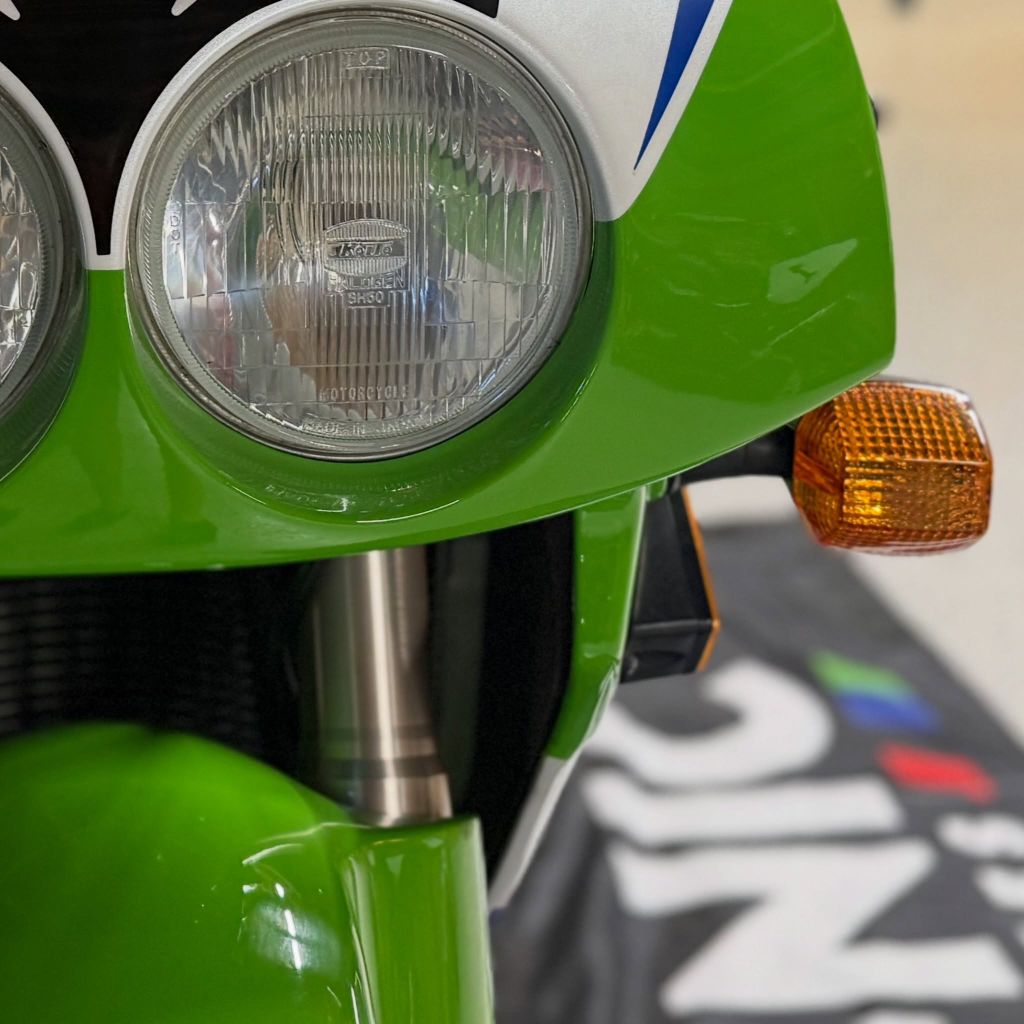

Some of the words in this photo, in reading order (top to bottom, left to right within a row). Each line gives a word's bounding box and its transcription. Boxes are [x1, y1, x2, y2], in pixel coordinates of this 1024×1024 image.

[344, 51, 386, 67] TOP
[319, 385, 408, 401] MOTORCYCLE
[579, 656, 1024, 1024] NIC
